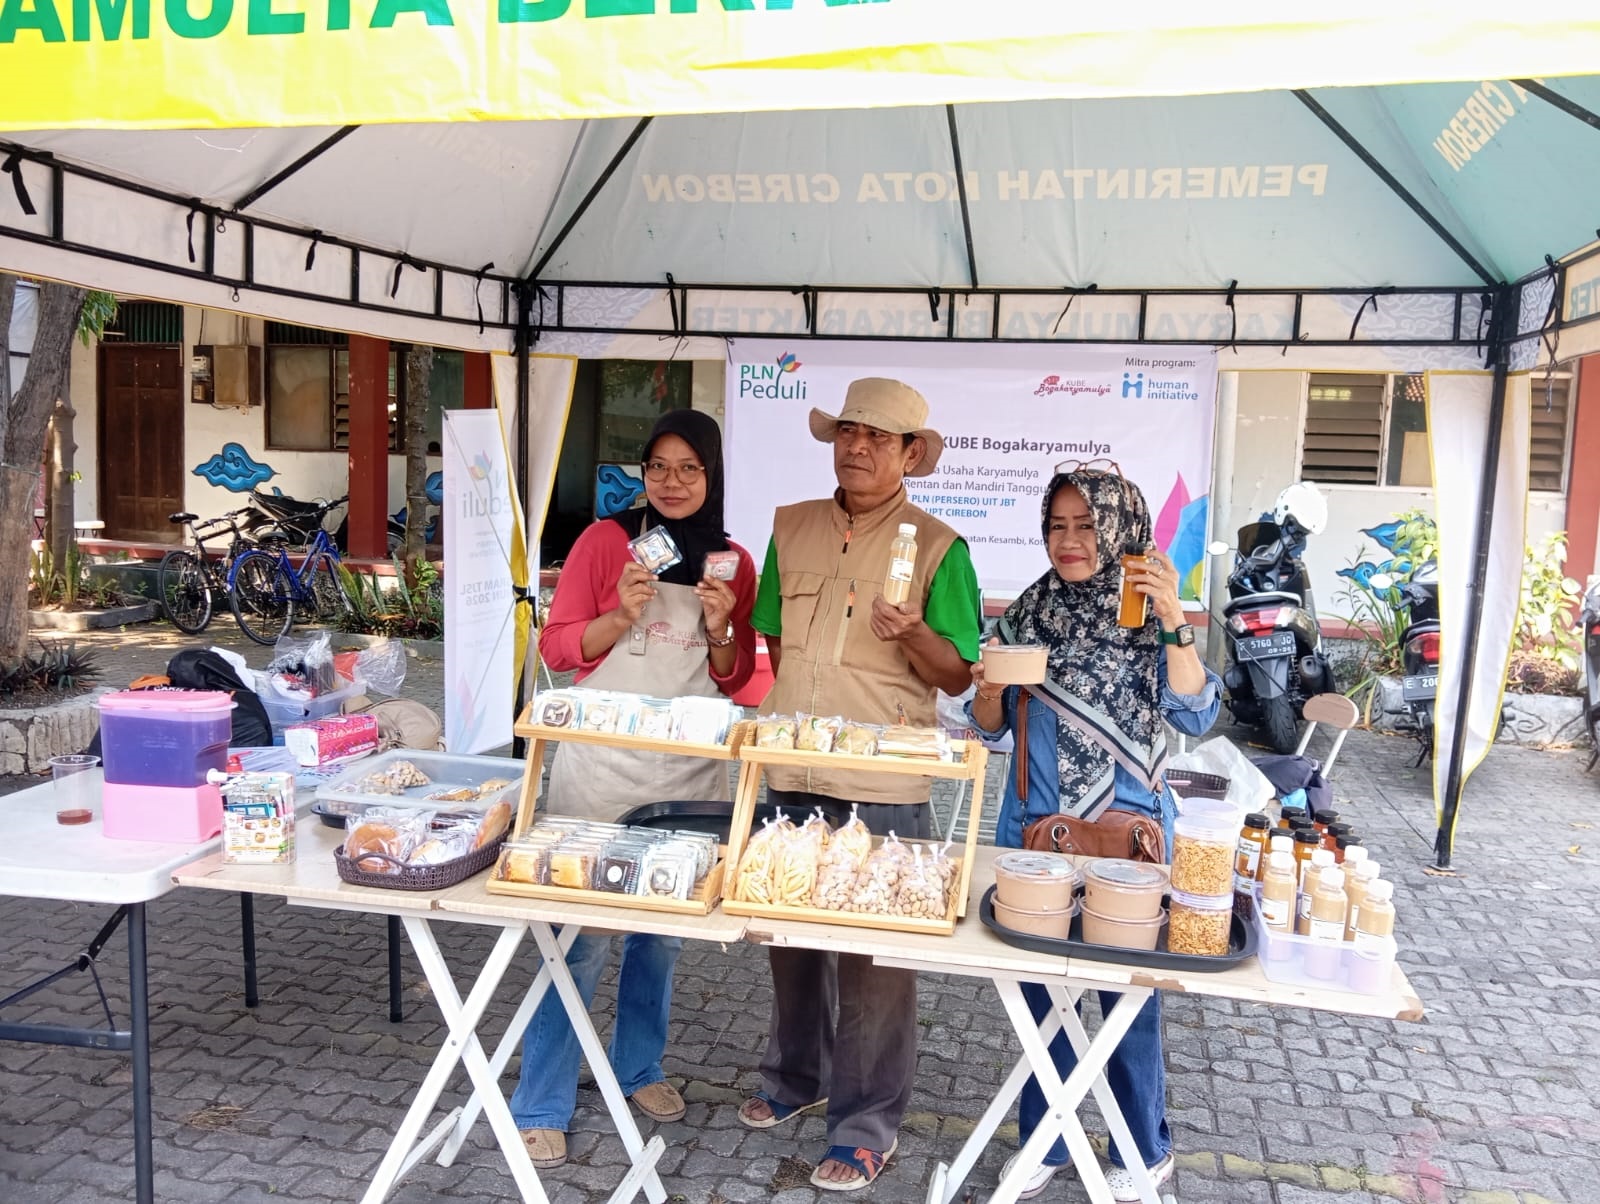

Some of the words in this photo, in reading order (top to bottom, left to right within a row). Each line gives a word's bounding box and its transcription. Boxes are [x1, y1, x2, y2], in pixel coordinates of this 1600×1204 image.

[1125, 357, 1150, 367] Mitra
[1152, 359, 1196, 370] program:
[741, 365, 774, 379] PLN
[740, 379, 807, 400] Peduli
[1149, 379, 1189, 390] human
[1148, 389, 1199, 401] initiative
[982, 437, 1111, 456] Bogakaryamulya
[943, 465, 974, 476] Usaha
[977, 466, 1039, 480] Karyamulya
[904, 478, 940, 490] Rentan
[942, 479, 962, 491] dan
[964, 480, 1005, 493] Mandiri
[1007, 482, 1049, 496] Tanggu
[911, 494, 930, 504] PLN
[931, 495, 980, 506] (PERSERO)
[982, 497, 998, 506] UIT
[999, 498, 1017, 507] JBT
[945, 508, 987, 518] CIREBON
[988, 535, 1027, 547] Kesambi,
[1028, 537, 1045, 546] Kot
[1250, 638, 1272, 649] 5760
[1406, 680, 1414, 689] E
